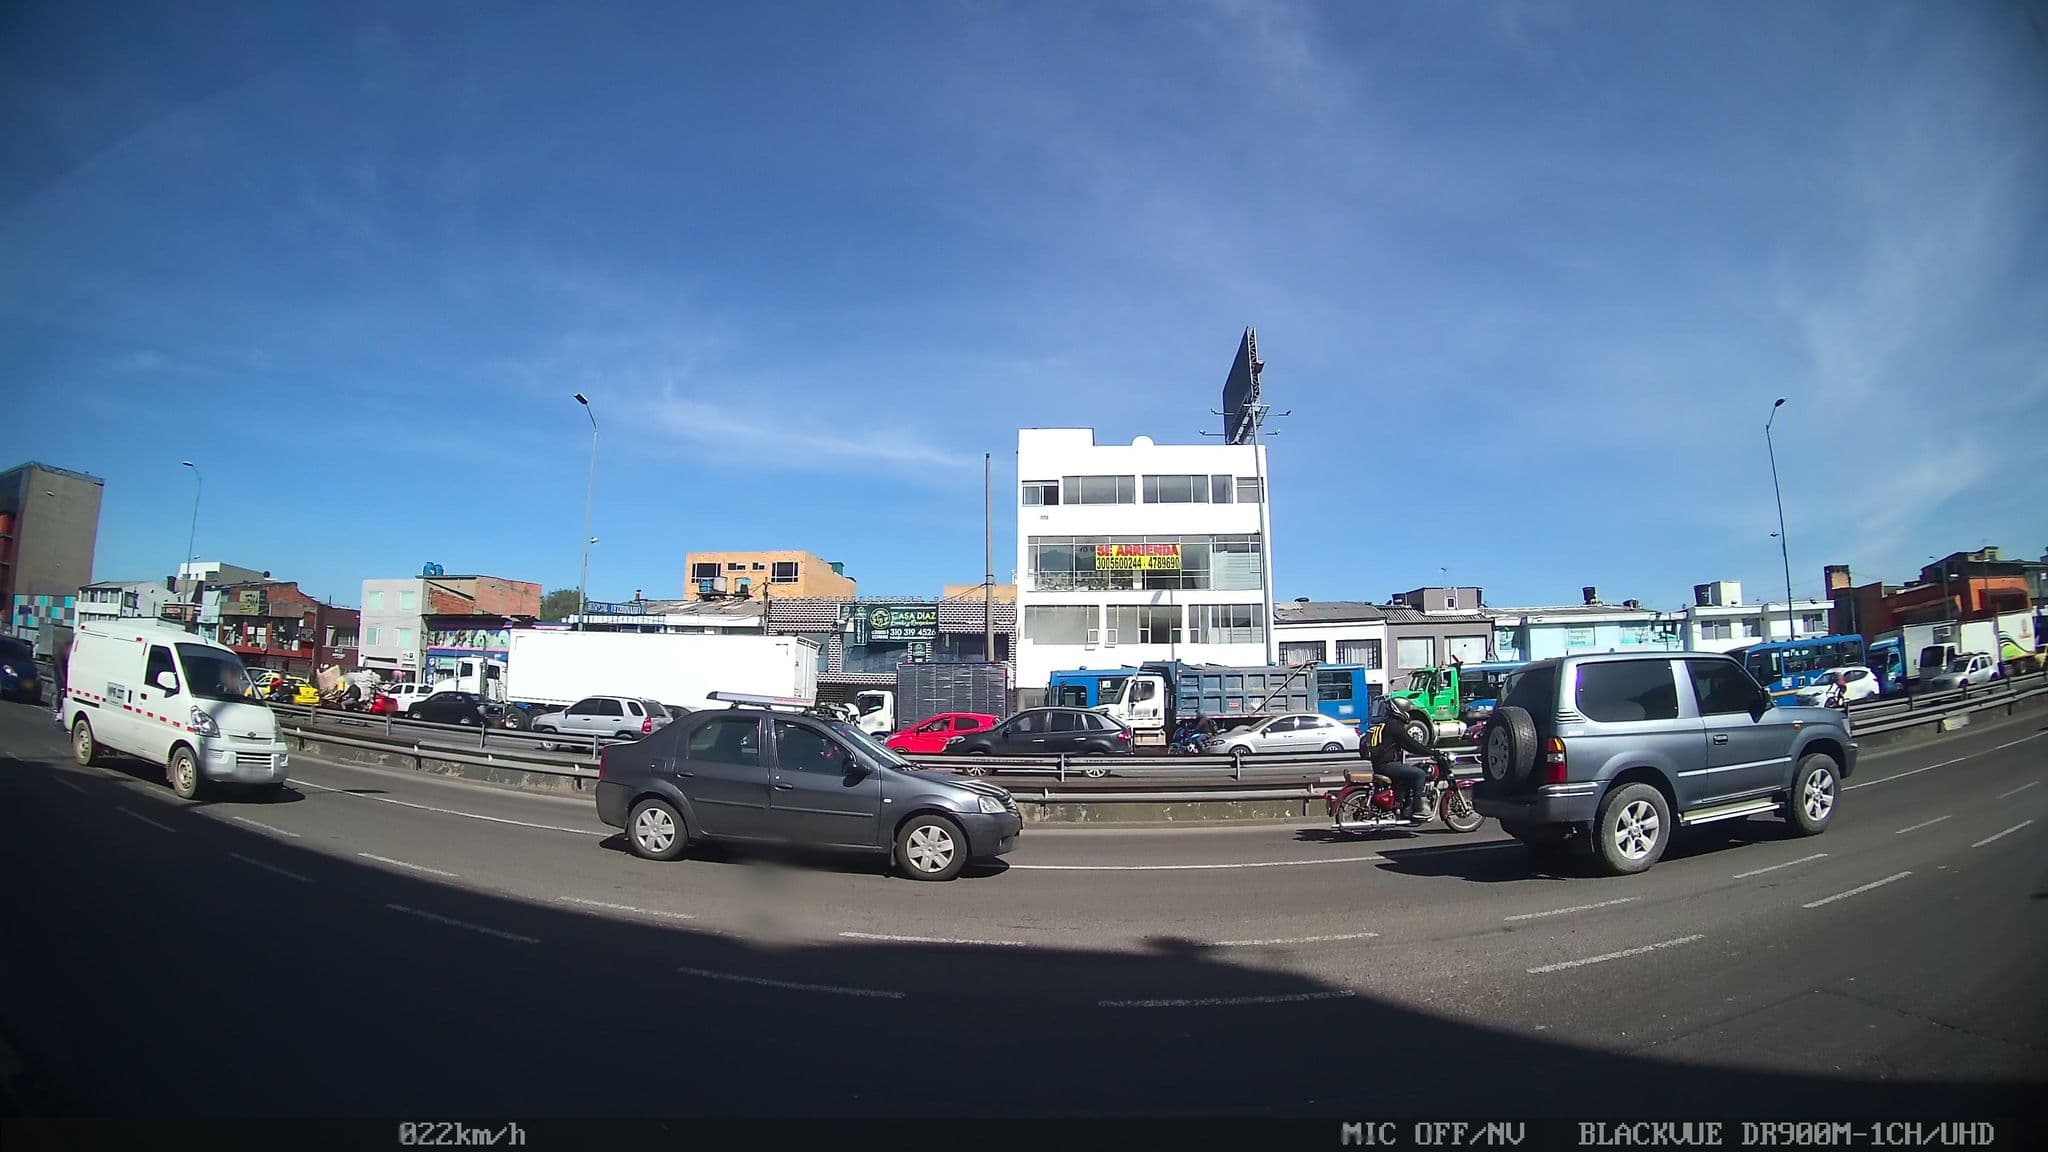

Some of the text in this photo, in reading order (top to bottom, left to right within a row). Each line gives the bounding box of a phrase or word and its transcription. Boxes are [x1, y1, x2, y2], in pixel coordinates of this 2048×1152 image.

[1097, 544, 1112, 556] SE
[1116, 544, 1178, 556] ARRIENDA
[891, 611, 936, 620] CASA DIAZ
[890, 628, 902, 636] 310
[903, 628, 915, 636] 319
